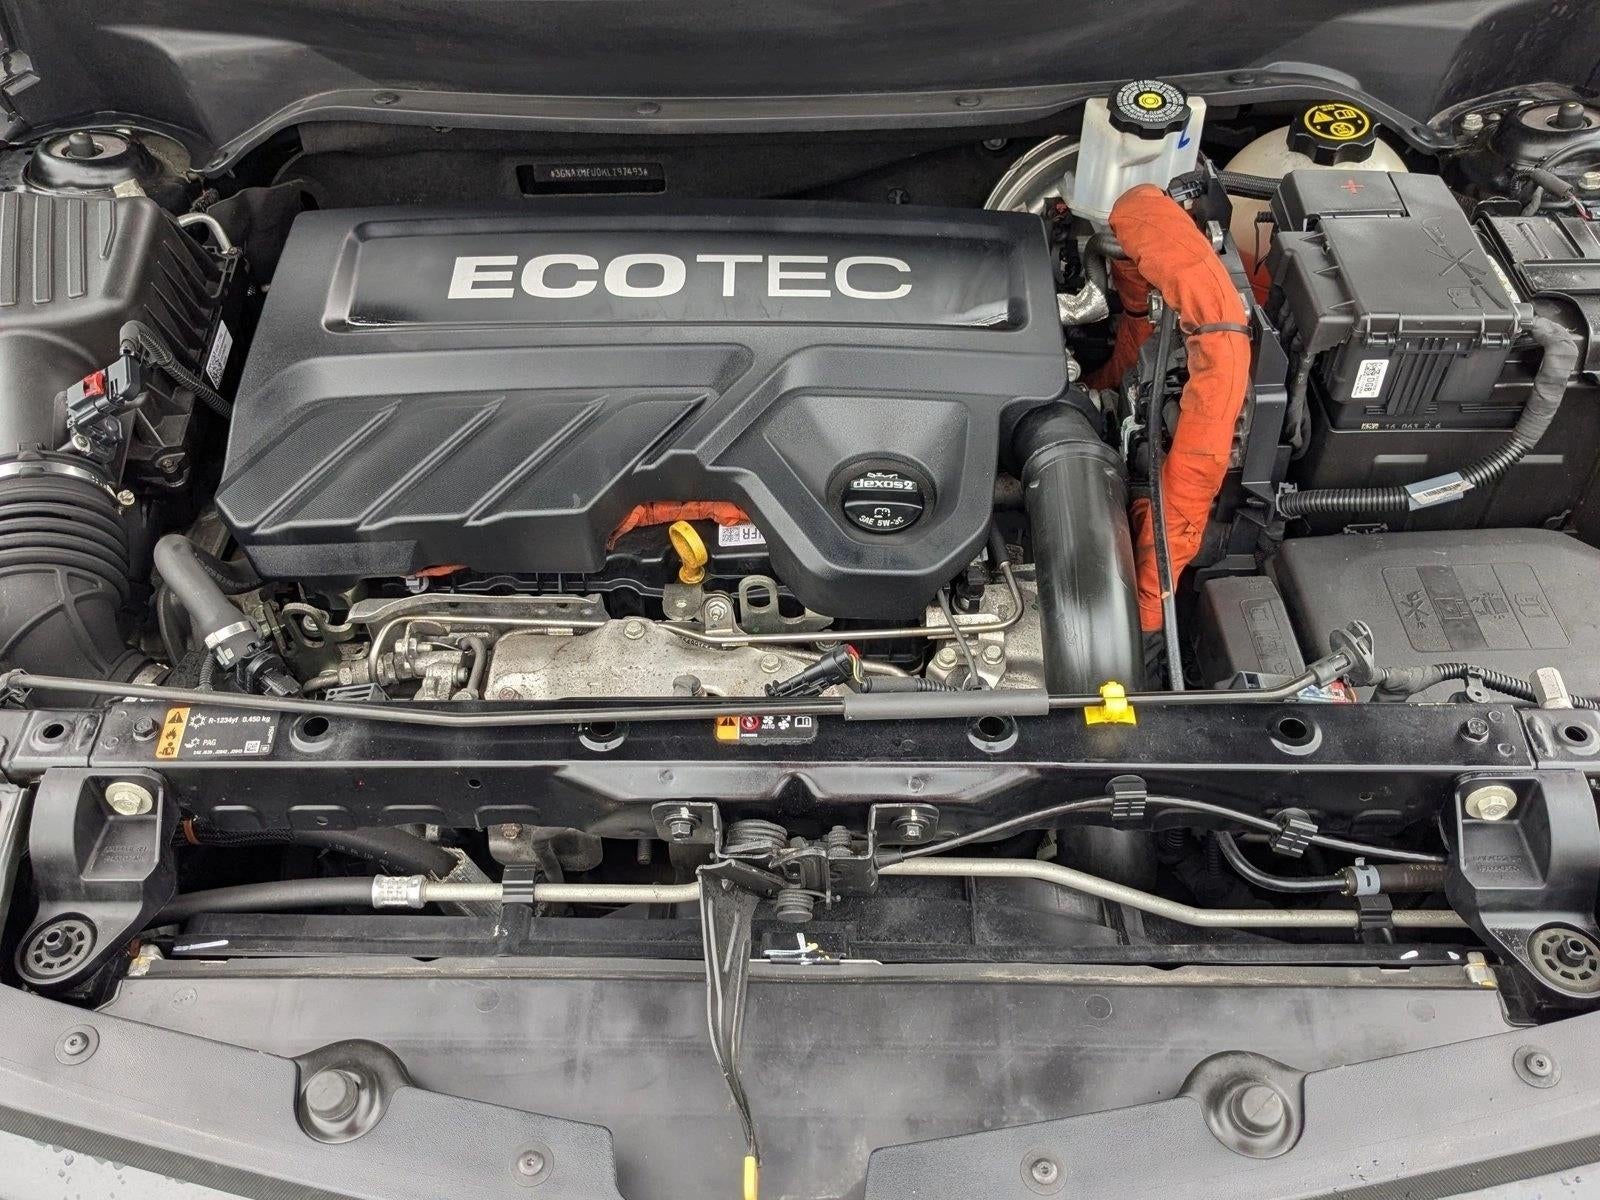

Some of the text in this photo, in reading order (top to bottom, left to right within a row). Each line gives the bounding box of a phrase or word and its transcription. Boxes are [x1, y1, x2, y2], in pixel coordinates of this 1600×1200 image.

[447, 253, 913, 299] ECOTEC
[853, 478, 913, 490] dexos2
[859, 515, 875, 525] SAE
[208, 716, 239, 725] R-1234yf
[261, 715, 272, 723] kg
